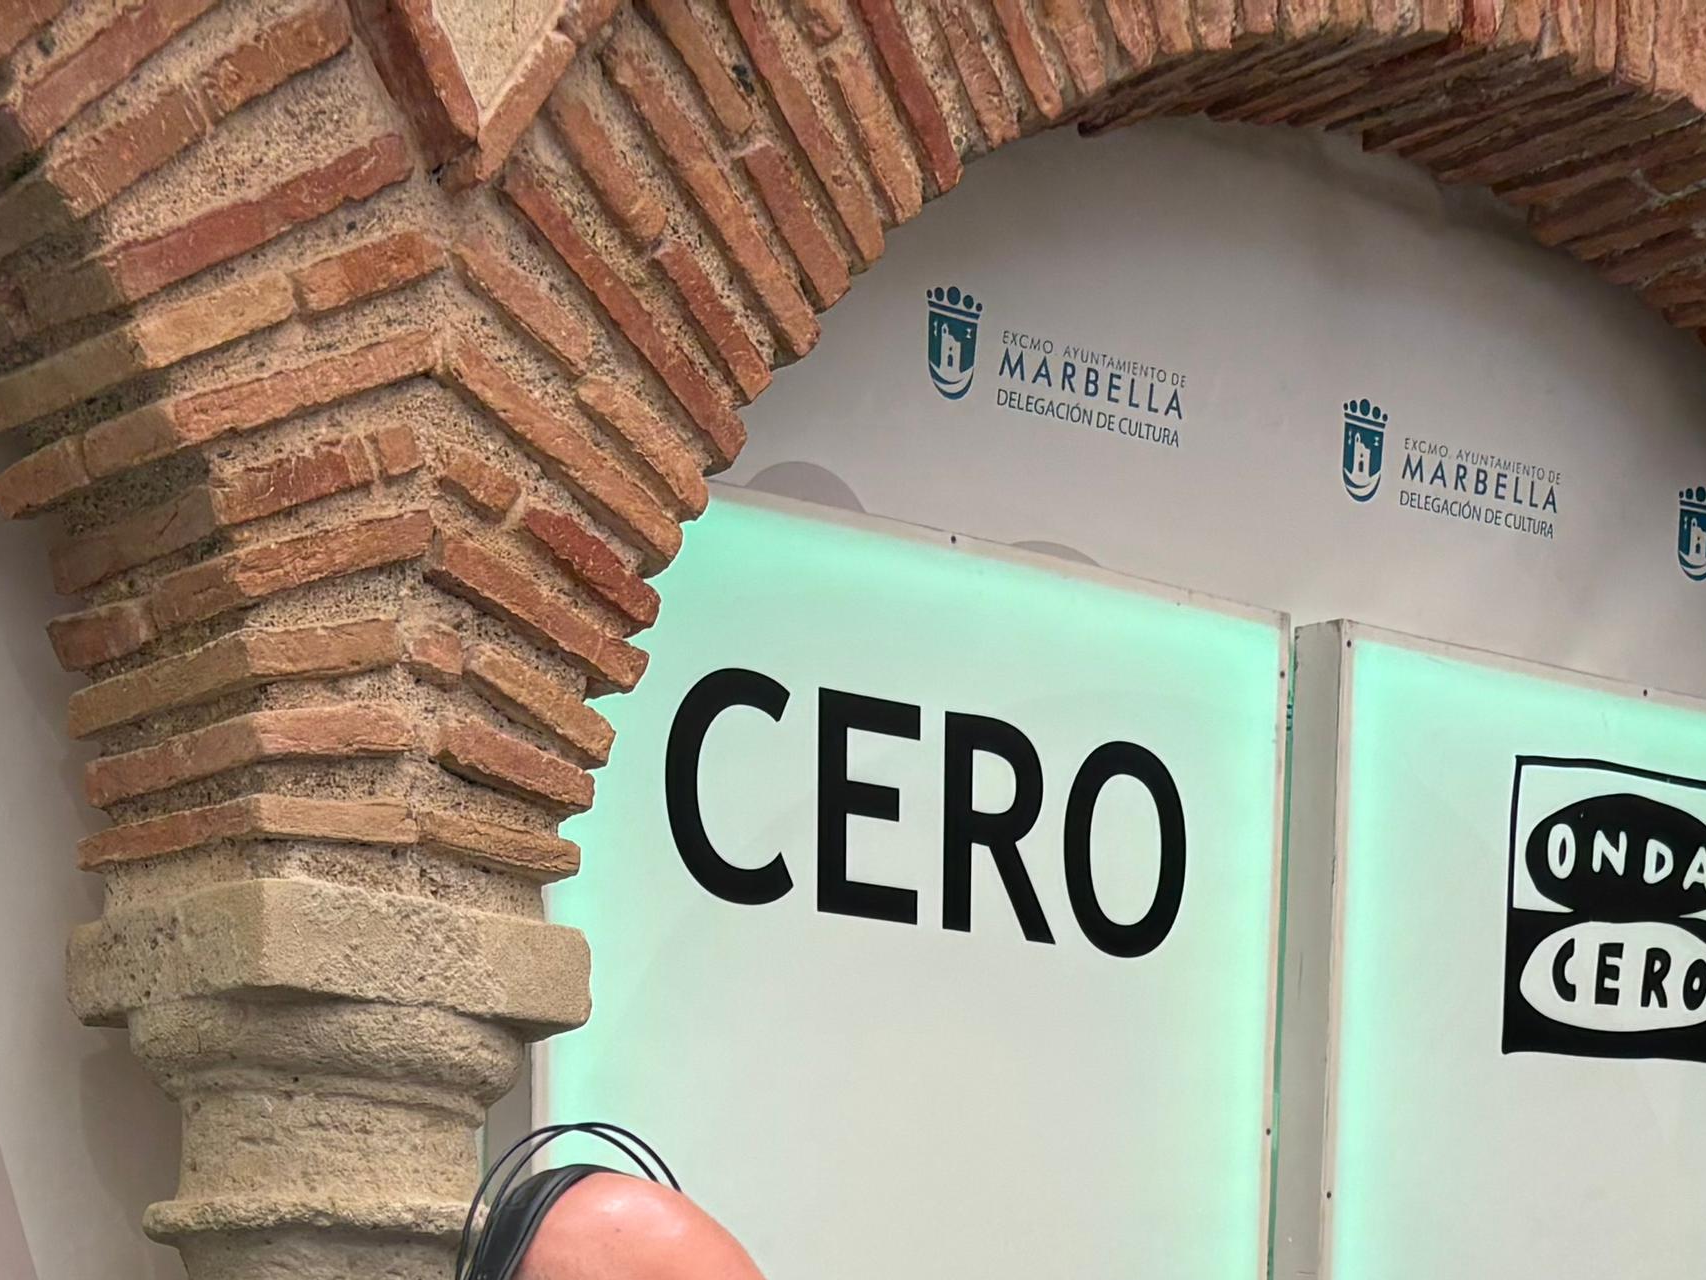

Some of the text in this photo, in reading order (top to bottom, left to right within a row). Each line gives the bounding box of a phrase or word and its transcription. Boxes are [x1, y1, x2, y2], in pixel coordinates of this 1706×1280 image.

[998, 347, 1183, 420] MARBELLA
[1063, 345, 1167, 384] AYUNTAMIENTO
[1171, 372, 1187, 389] DE
[997, 388, 1180, 448] DELEGACIÓN DE CULTURA
[1401, 453, 1558, 514] MARBELLA
[1456, 449, 1545, 481] AYUNTAMIENTO
[1548, 470, 1562, 485] DE
[1399, 490, 1554, 539] DELEGACIÓN DE CULTURA
[665, 667, 1187, 958] CERO
